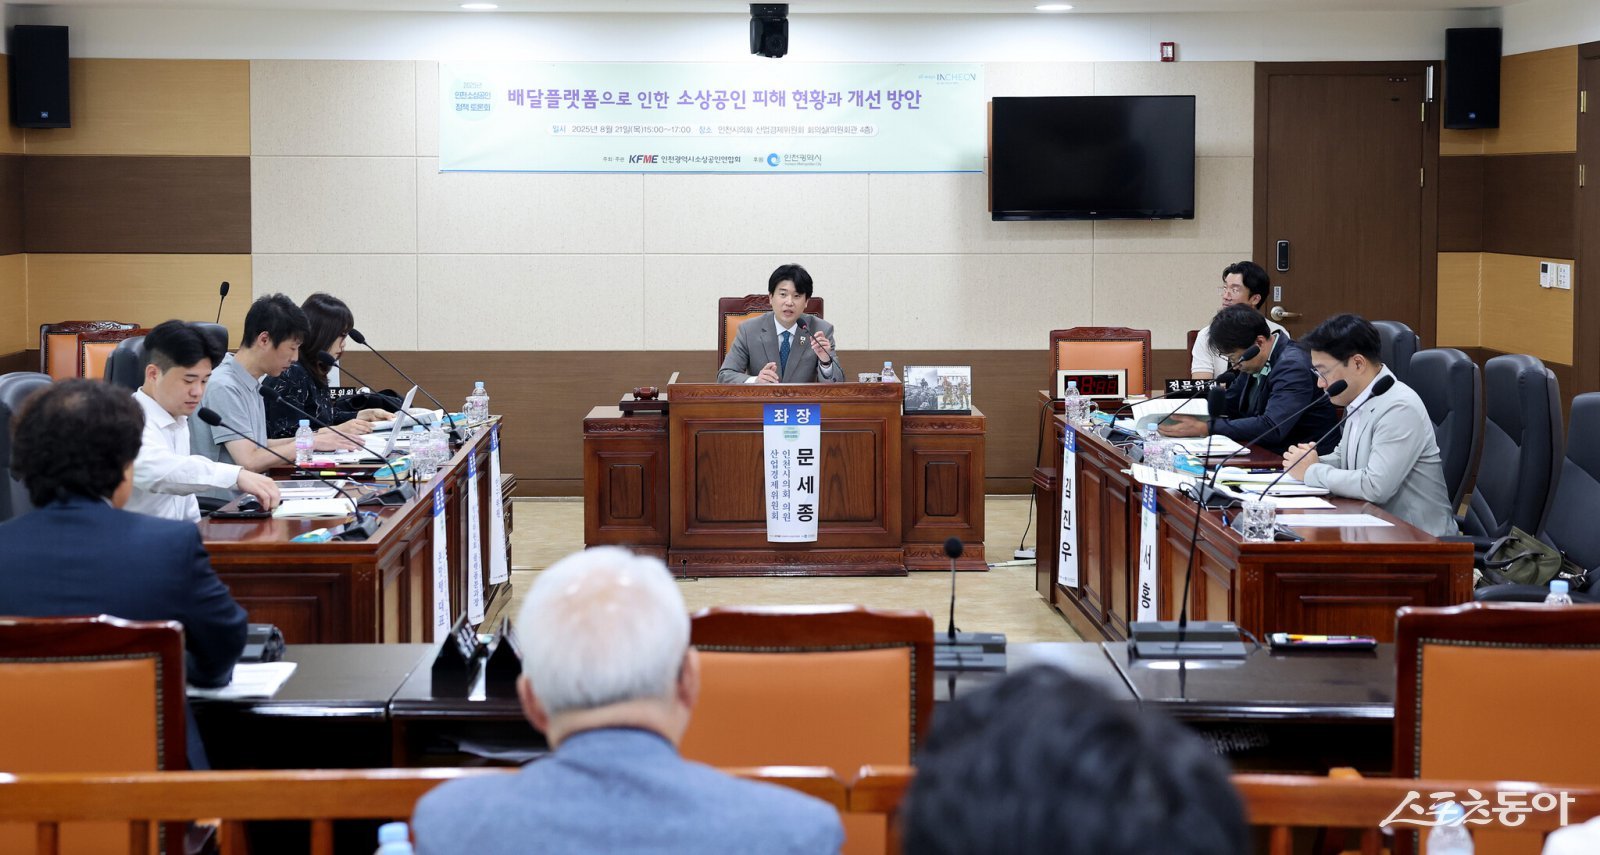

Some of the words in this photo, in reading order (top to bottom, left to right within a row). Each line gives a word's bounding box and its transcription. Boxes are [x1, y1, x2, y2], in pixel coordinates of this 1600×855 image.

[936, 73, 976, 81] INCHEON
[507, 88, 632, 110] 배달플랫폼으로
[638, 91, 670, 110] 인한
[676, 90, 746, 110] 소상공인
[752, 90, 786, 108] 피해
[792, 90, 842, 110] 현황과
[847, 90, 881, 110] 개선
[886, 90, 922, 110] 방안
[455, 103, 470, 112] 정책
[470, 103, 491, 112] 토론회
[552, 125, 566, 134] 일시
[572, 125, 598, 134] 2025년
[600, 125, 613, 134] 8월
[699, 126, 712, 134] 장소
[718, 126, 753, 134] 인천시의회
[756, 126, 804, 134] 산업경제위원회
[628, 154, 658, 164] KFME
[784, 154, 822, 162] 인천광역시
[774, 408, 810, 424] 좌장
[782, 450, 790, 499] 인천시의회
[770, 450, 778, 520] 산업경제위원회
[796, 448, 814, 522] 문세종
[782, 502, 790, 522] 의원
